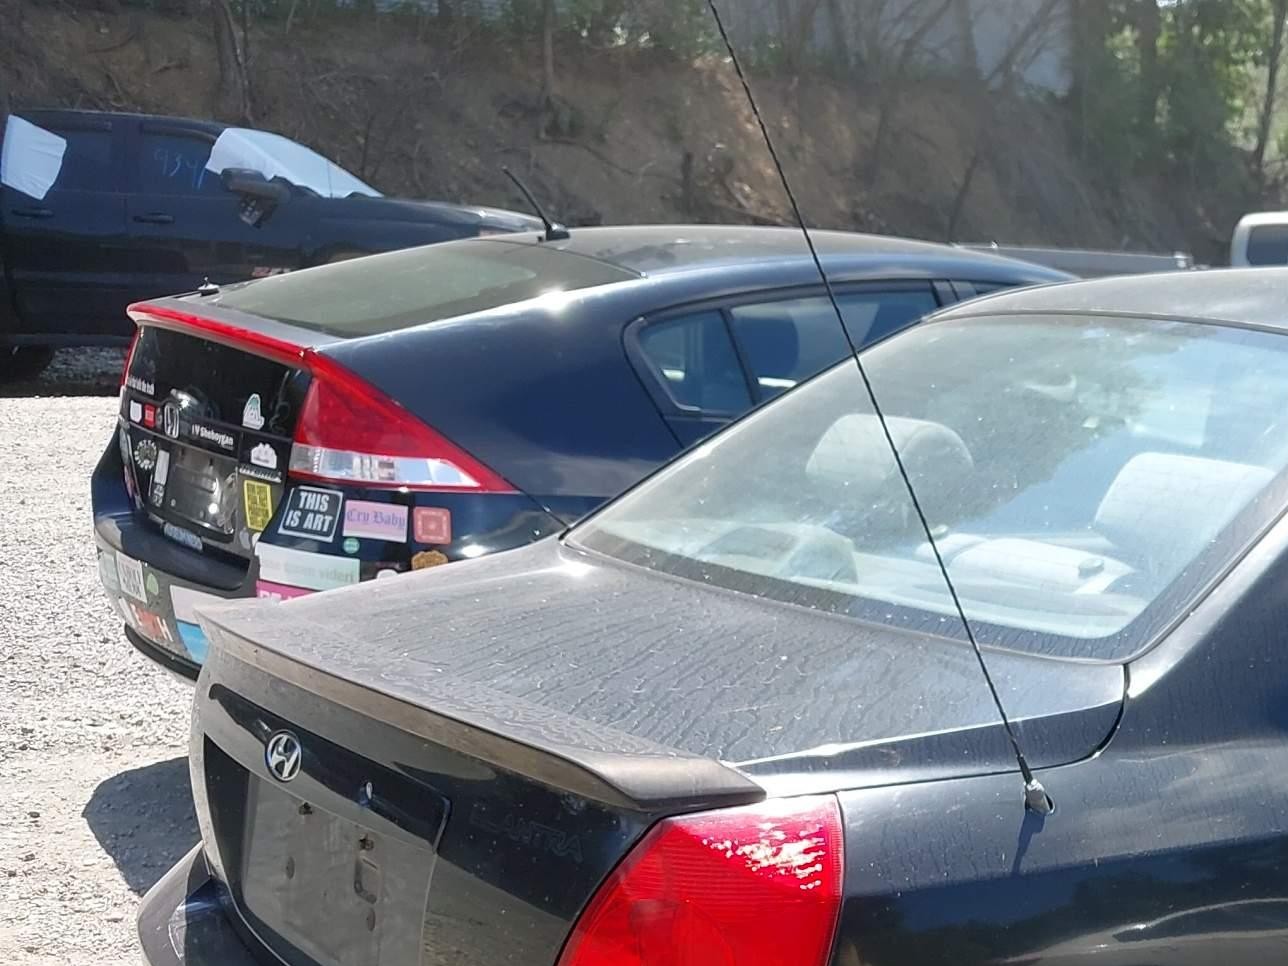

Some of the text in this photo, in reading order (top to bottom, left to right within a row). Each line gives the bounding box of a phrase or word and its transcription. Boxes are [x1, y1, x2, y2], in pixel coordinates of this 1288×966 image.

[299, 491, 330, 512] THIS
[285, 509, 334, 533] IS ART
[346, 508, 370, 524] Cry
[373, 509, 406, 528] Baby
